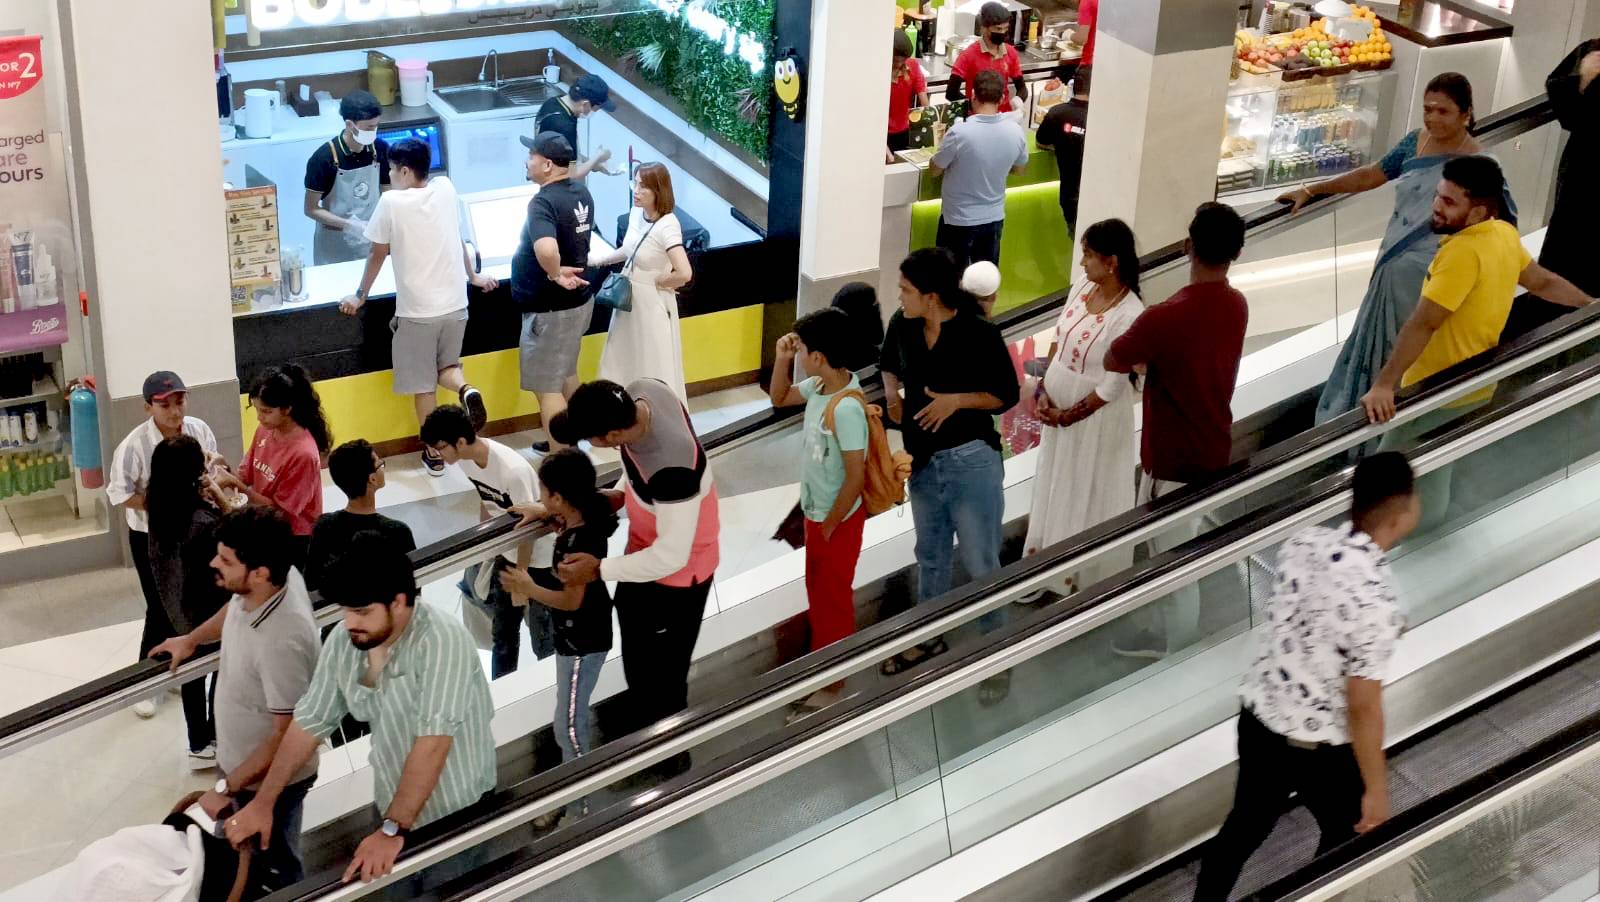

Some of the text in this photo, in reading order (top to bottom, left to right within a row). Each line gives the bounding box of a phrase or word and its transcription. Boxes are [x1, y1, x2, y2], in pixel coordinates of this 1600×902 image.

[18, 52, 37, 79] 2
[0, 128, 45, 150] arged
[0, 167, 44, 184] ours
